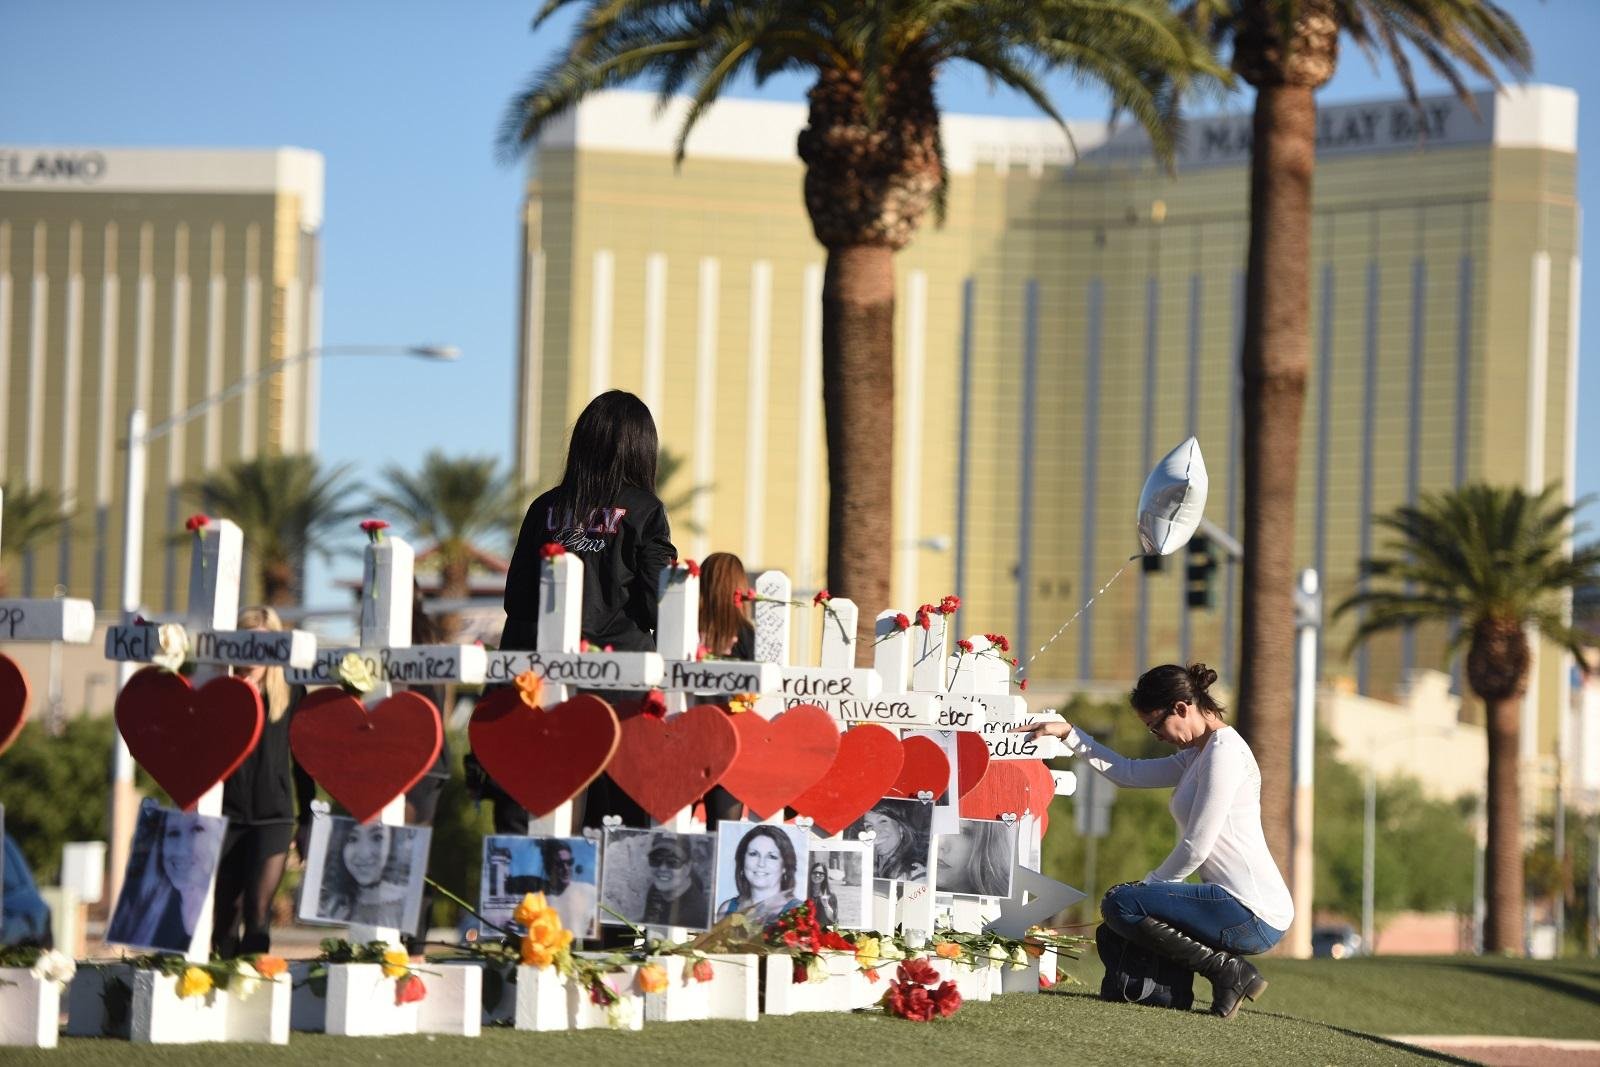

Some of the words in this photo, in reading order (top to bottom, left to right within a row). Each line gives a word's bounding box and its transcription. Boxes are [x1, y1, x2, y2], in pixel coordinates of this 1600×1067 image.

[1389, 104, 1450, 142] BAY
[545, 506, 627, 533] ULV
[195, 633, 290, 662] Meadows
[527, 653, 620, 681] Beaton
[672, 663, 760, 691] Anderson
[936, 706, 974, 726] eber
